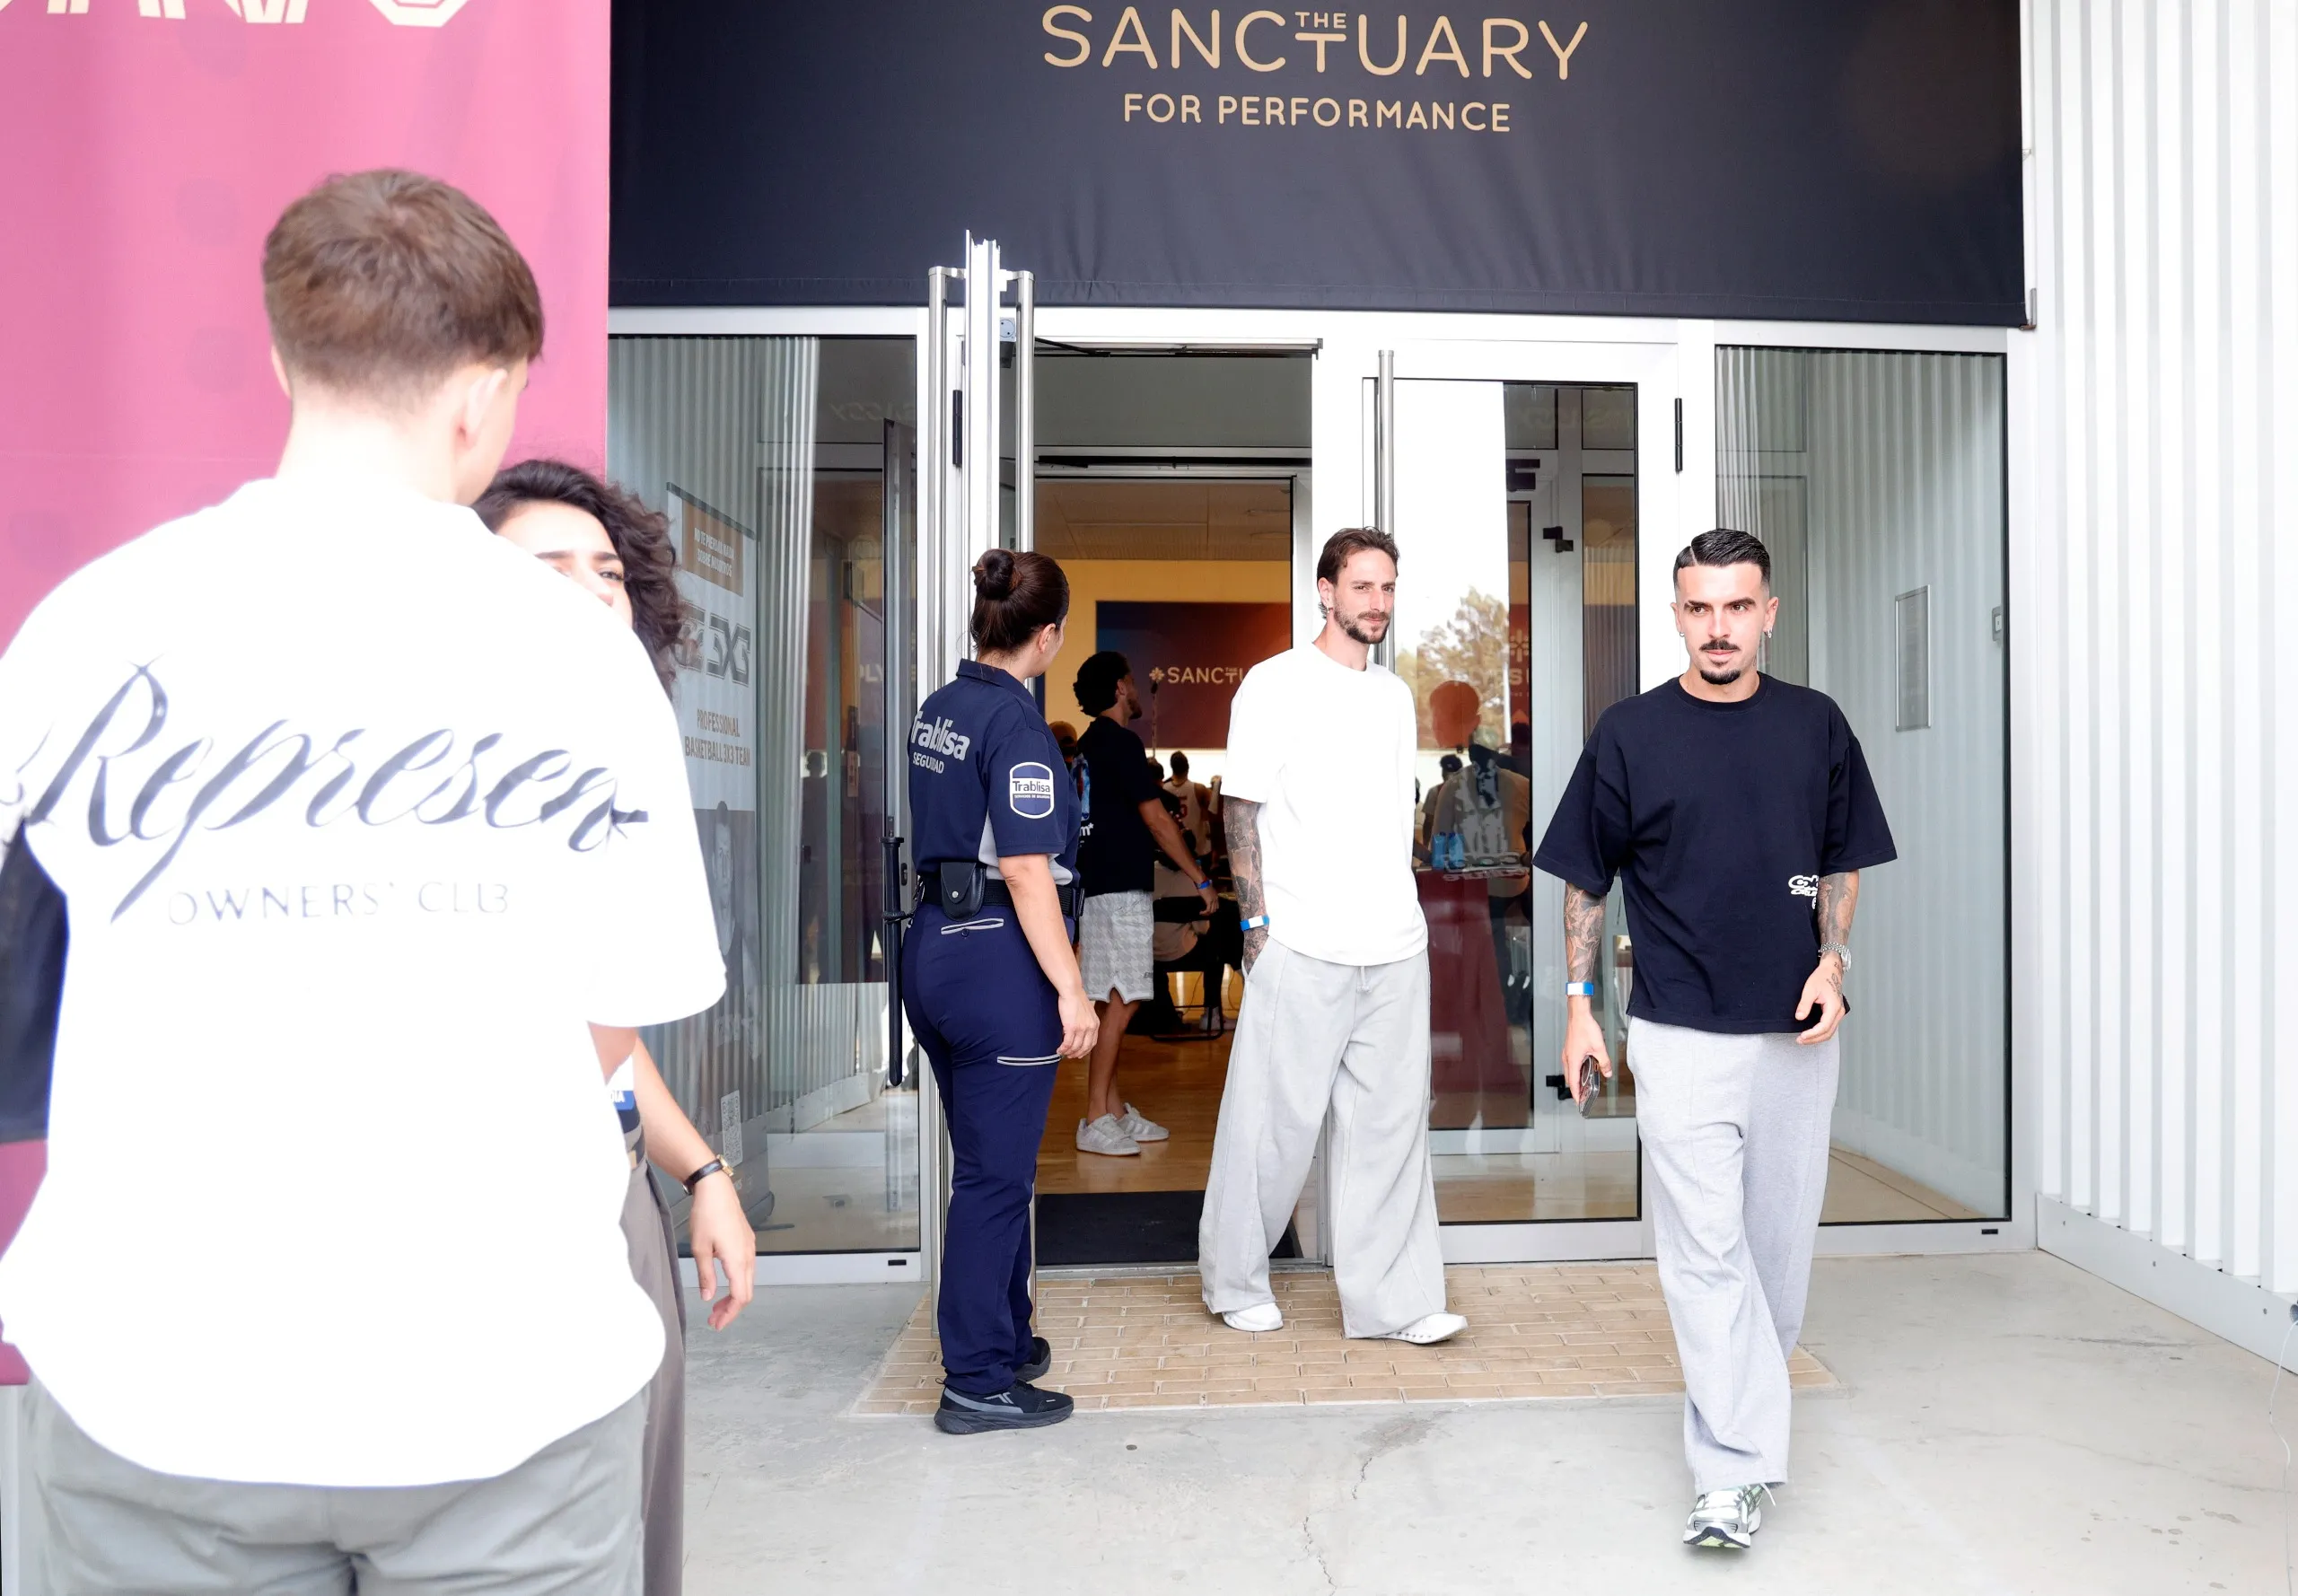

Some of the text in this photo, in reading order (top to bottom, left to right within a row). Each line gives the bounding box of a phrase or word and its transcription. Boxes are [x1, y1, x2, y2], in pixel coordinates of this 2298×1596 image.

[1294, 11, 1346, 30] THE
[1041, 4, 1589, 82] SANCTUARY
[1124, 93, 1511, 132] FOR PERFORMANCE
[1167, 666, 1243, 685] SANCT
[697, 708, 741, 737] PROFESSIONAL
[684, 736, 724, 762] BASKETBALL
[1013, 780, 1050, 794] Trablisa
